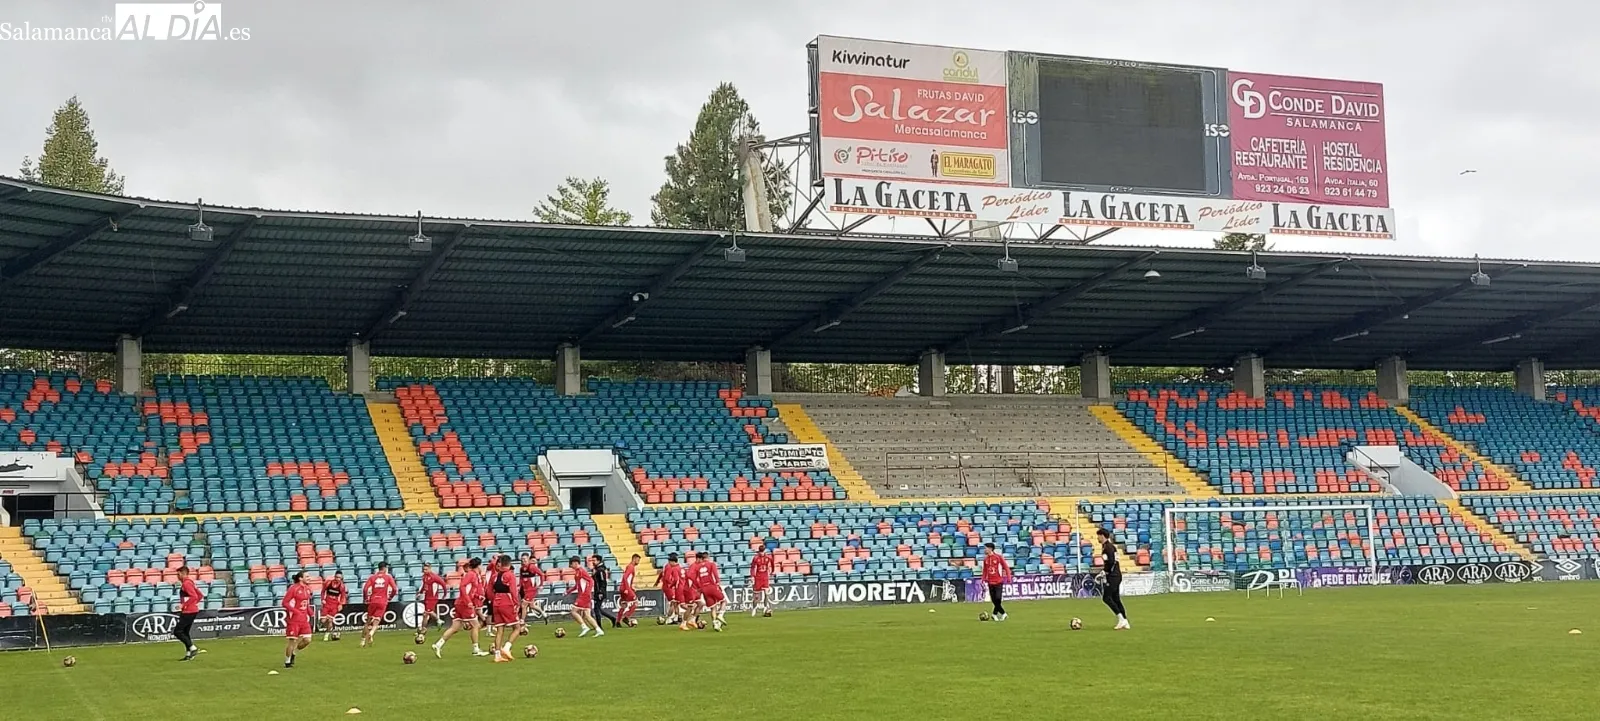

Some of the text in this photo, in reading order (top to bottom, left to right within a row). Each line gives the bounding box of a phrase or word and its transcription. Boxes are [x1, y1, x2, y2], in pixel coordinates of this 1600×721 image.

[832, 50, 910, 69] Kiwinatur
[917, 89, 985, 103] FRUTAS DAVID
[1232, 79, 1266, 119] CD
[1268, 90, 1380, 117] CONDE DAVID
[832, 84, 996, 127] Salazar
[1012, 110, 1039, 125] ISO
[1286, 117, 1363, 132] SALAMANCA
[894, 124, 987, 140] Mercasalamanca
[1205, 123, 1230, 137] ISO
[1250, 136, 1308, 155] CAFETERÍA
[1322, 141, 1362, 158] HOSTAL
[944, 156, 952, 168] EL
[953, 157, 992, 171] MARAGATO
[1235, 151, 1308, 170] RESTAURANTE
[1323, 156, 1383, 174] RESIDENCIA
[1295, 175, 1309, 184] 163
[1369, 179, 1379, 187] 60
[834, 178, 972, 213] LA GACETA
[1255, 183, 1310, 195] 923 24 06 23
[1324, 186, 1378, 198] 923 61 44 79
[982, 190, 1052, 209] Periódico
[1062, 191, 1190, 223] LA GACETA
[1198, 202, 1263, 221] Periódico
[1272, 203, 1389, 233] LA GACETA
[758, 446, 824, 459] SENTIMIENTO
[1278, 569, 1296, 579] DI
[1424, 567, 1450, 581] ARA
[1462, 565, 1488, 579] ARA
[1500, 564, 1526, 578] ARA
[1321, 573, 1344, 585] FEDE
[827, 581, 926, 603] MORETA
[1002, 581, 1073, 596] EDE BLAZQUEZ
[601, 599, 614, 609] són
[259, 610, 287, 628] AR
